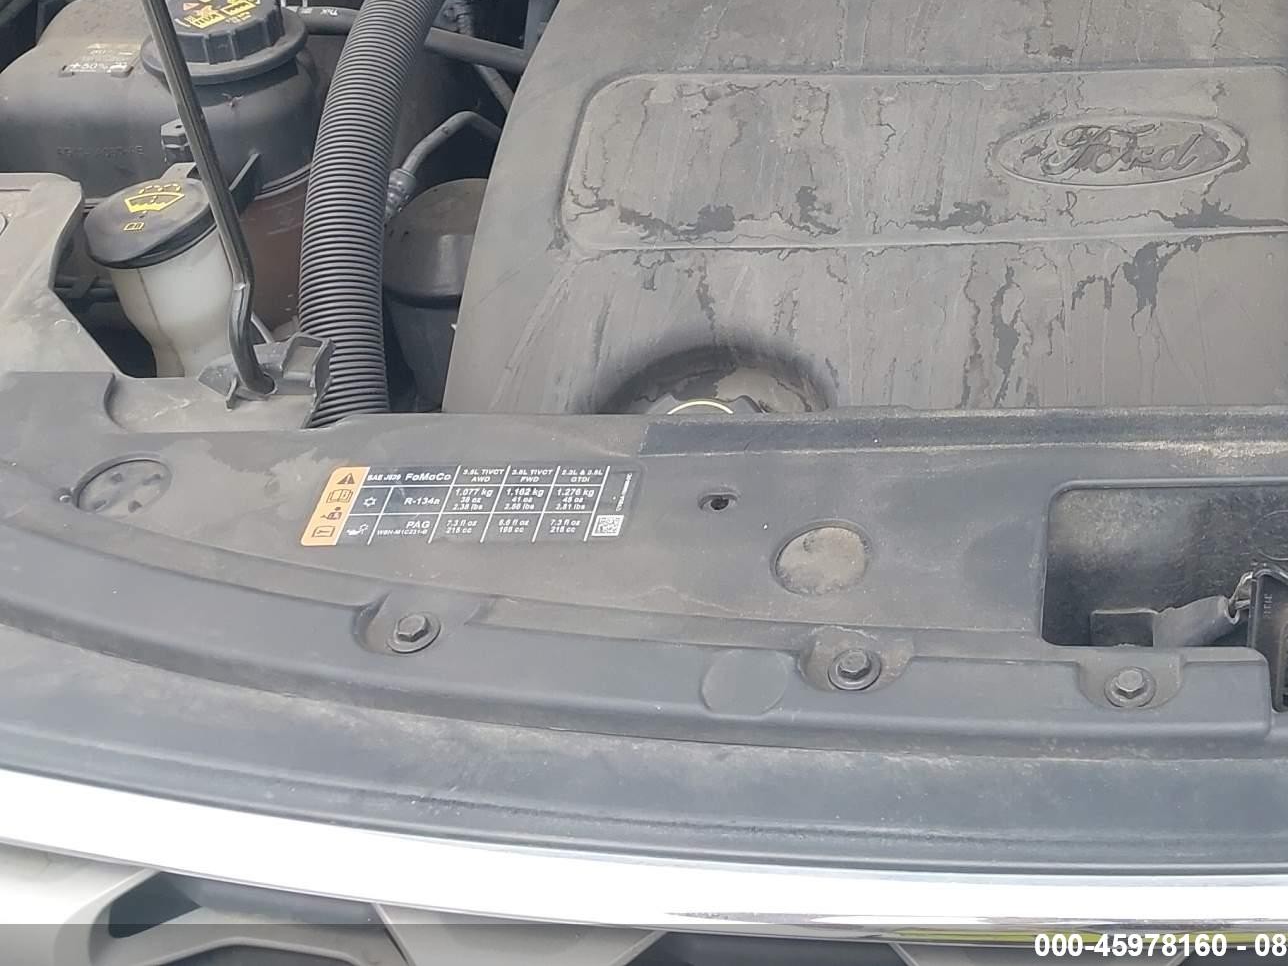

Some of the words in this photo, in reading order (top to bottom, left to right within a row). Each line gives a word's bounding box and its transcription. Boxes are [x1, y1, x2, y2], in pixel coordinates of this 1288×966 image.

[1041, 122, 1202, 175] Ford
[405, 473, 451, 481] FoMoCo
[456, 488, 479, 496] 1.077
[481, 488, 493, 497] kg
[532, 488, 544, 497] kg
[583, 488, 595, 497] kg
[404, 497, 440, 505] R-134a
[406, 520, 430, 528] PAG
